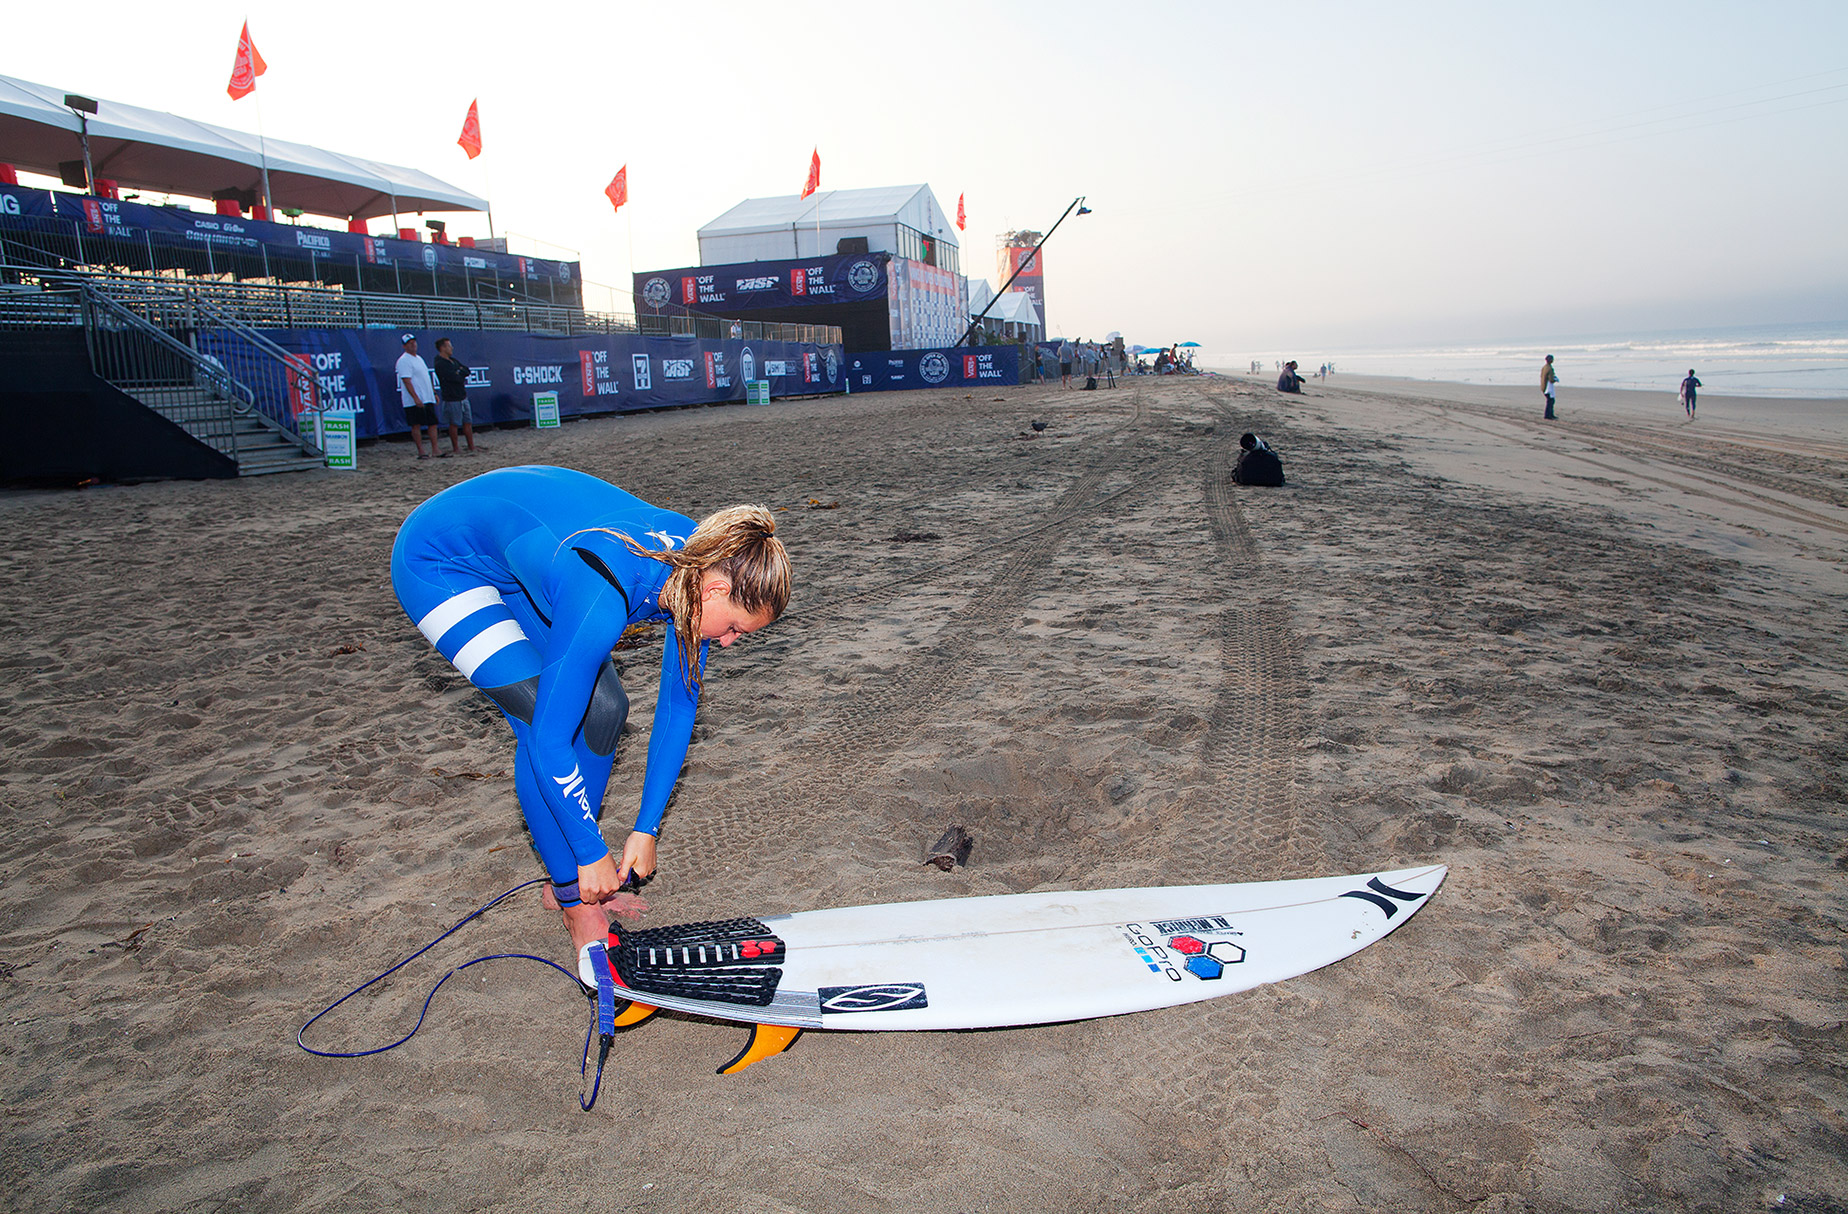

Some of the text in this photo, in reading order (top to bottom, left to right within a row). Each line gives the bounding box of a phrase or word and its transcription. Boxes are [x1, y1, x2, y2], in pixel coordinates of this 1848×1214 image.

[104, 214, 121, 225] THE
[194, 219, 219, 231] CASIO
[796, 275, 804, 294] VANS
[808, 276, 825, 285] THE
[686, 284, 694, 302] VANS
[698, 285, 714, 293] THE
[513, 366, 563, 385] G-SHOCK
[585, 361, 593, 393] VANS
[596, 366, 610, 379] THE
[715, 364, 725, 375] THE
[319, 375, 346, 394] THE
[1154, 919, 1211, 935] MERRICK
[1211, 916, 1230, 930] AL
[1126, 923, 1182, 982] GoPro
